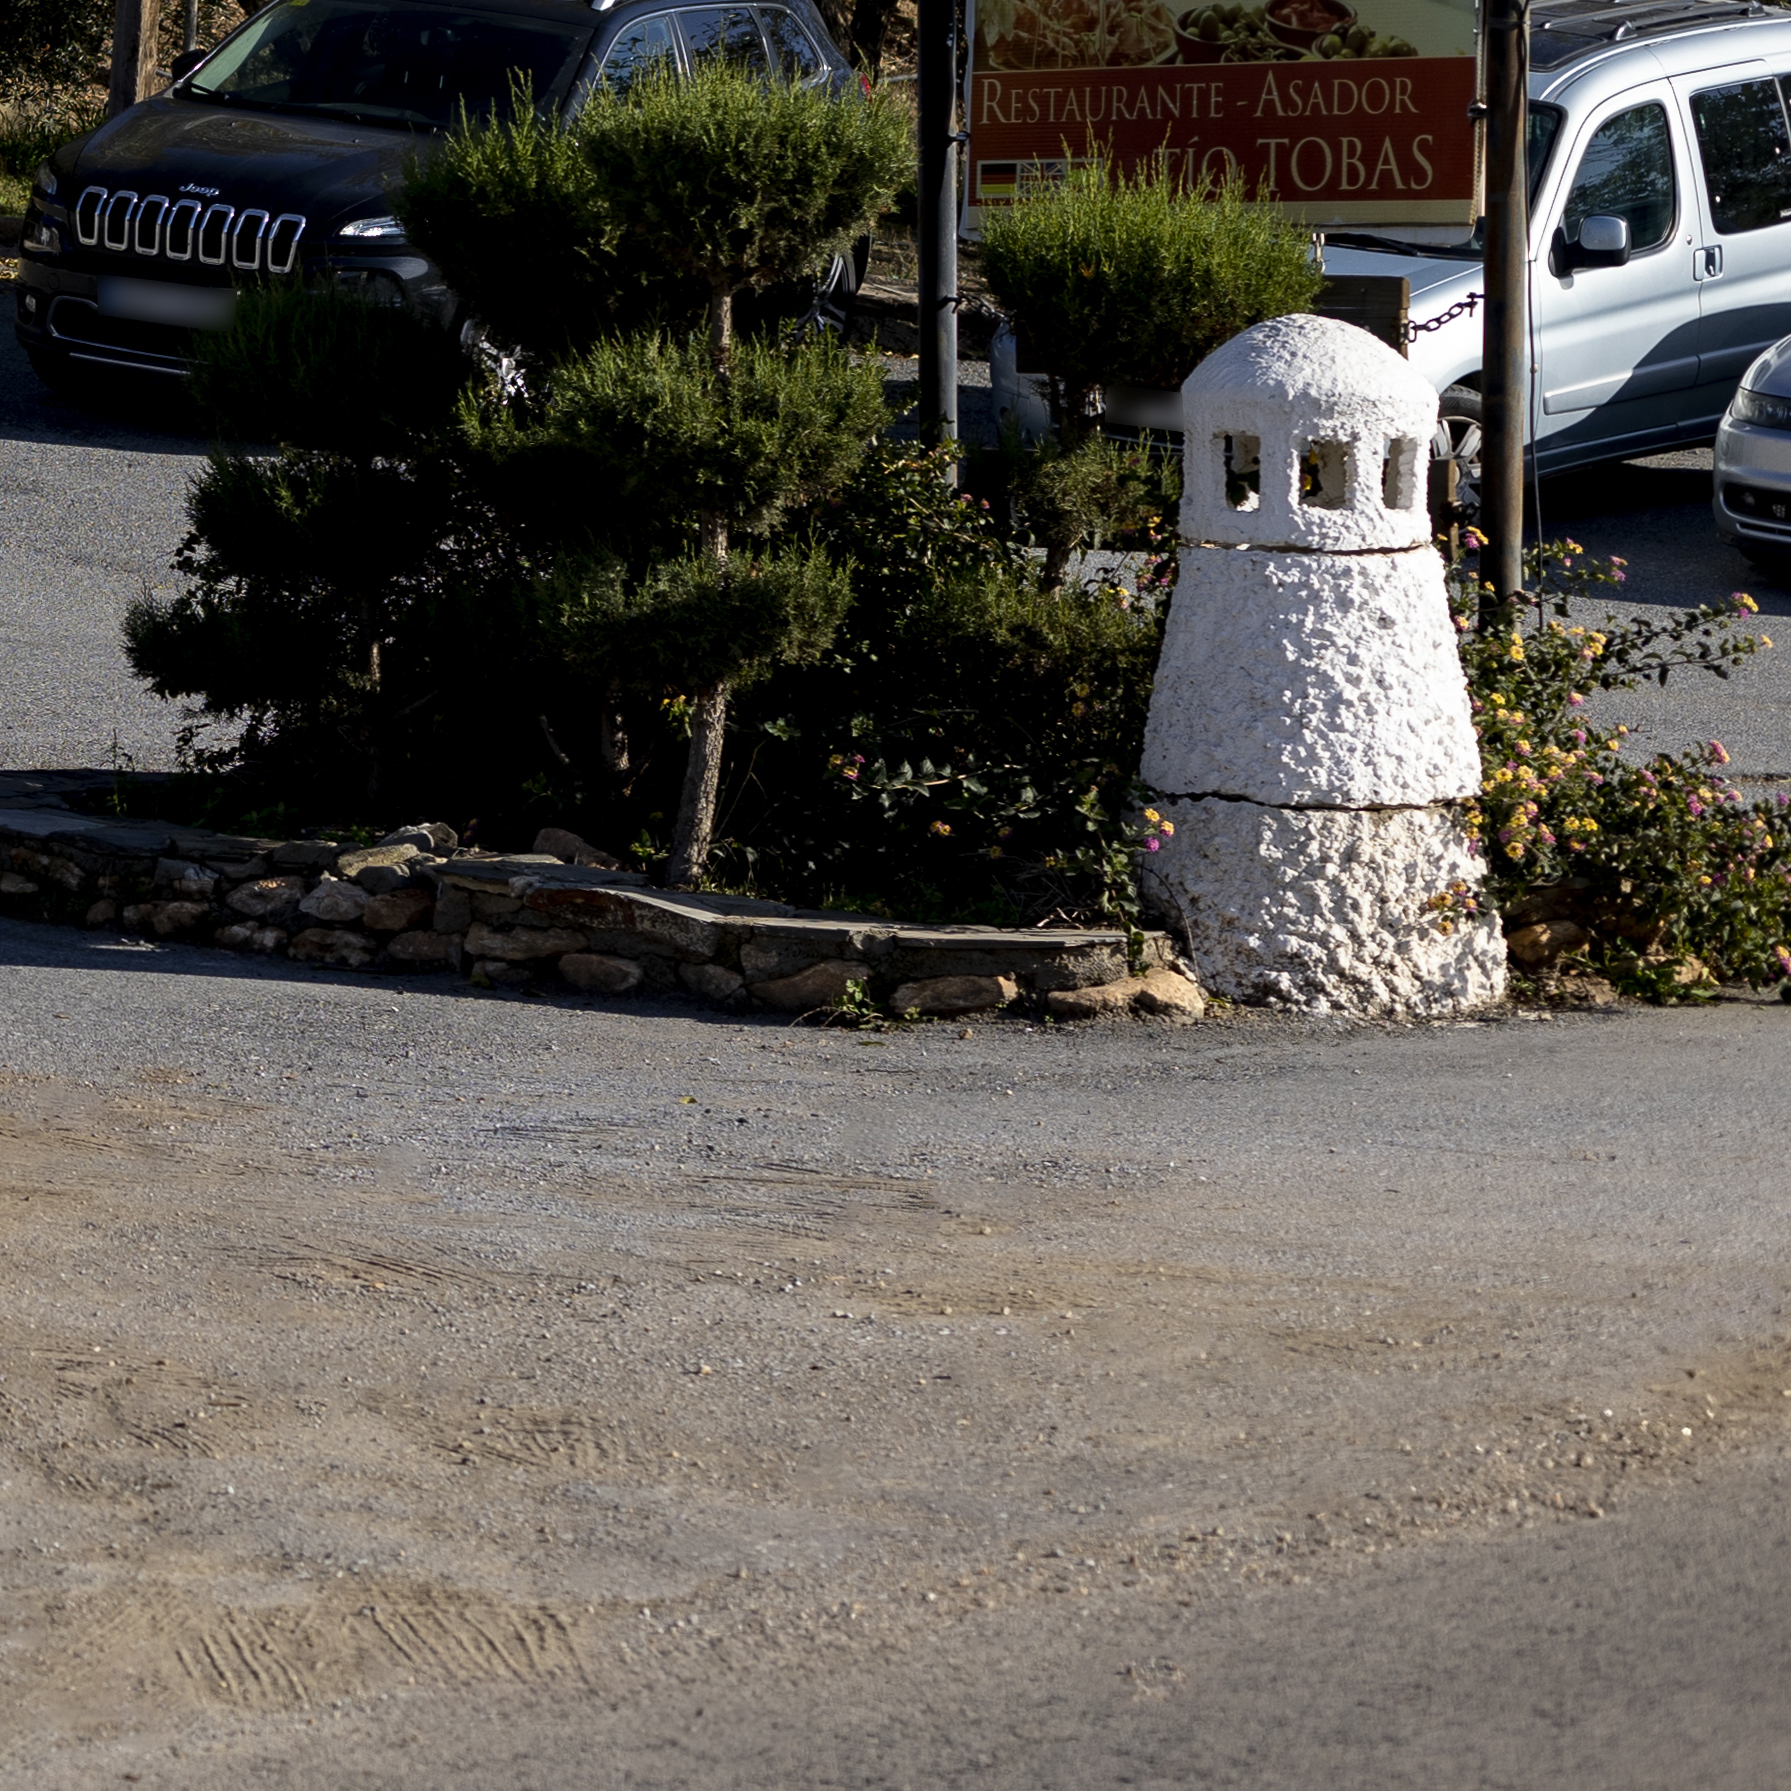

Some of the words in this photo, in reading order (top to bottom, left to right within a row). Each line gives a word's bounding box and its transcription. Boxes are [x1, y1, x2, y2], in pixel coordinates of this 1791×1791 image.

[1153, 135, 1238, 193] TÍO
[1256, 134, 1434, 192] TOBAS
[178, 182, 220, 197] Jeep
